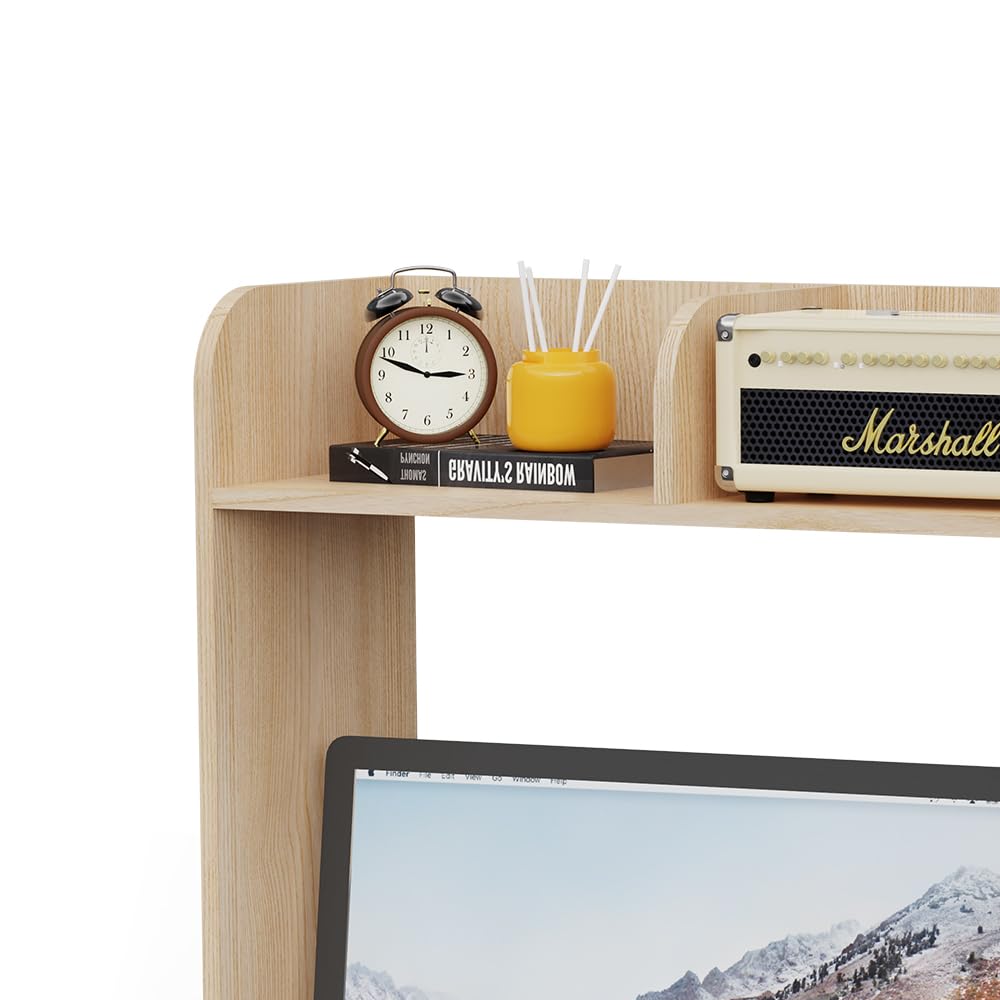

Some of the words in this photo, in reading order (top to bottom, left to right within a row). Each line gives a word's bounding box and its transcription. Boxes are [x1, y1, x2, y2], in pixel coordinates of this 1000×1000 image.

[420, 323, 434, 335] 12
[398, 330, 410, 341] 11
[382, 346, 396, 358] 10
[462, 345, 470, 357] 2
[378, 369, 386, 381] 9
[468, 368, 476, 380] 3
[385, 392, 393, 403] 8
[462, 391, 470, 402] 4
[401, 408, 409, 420] 7
[423, 414, 432, 426] 6
[445, 408, 454, 420] 5
